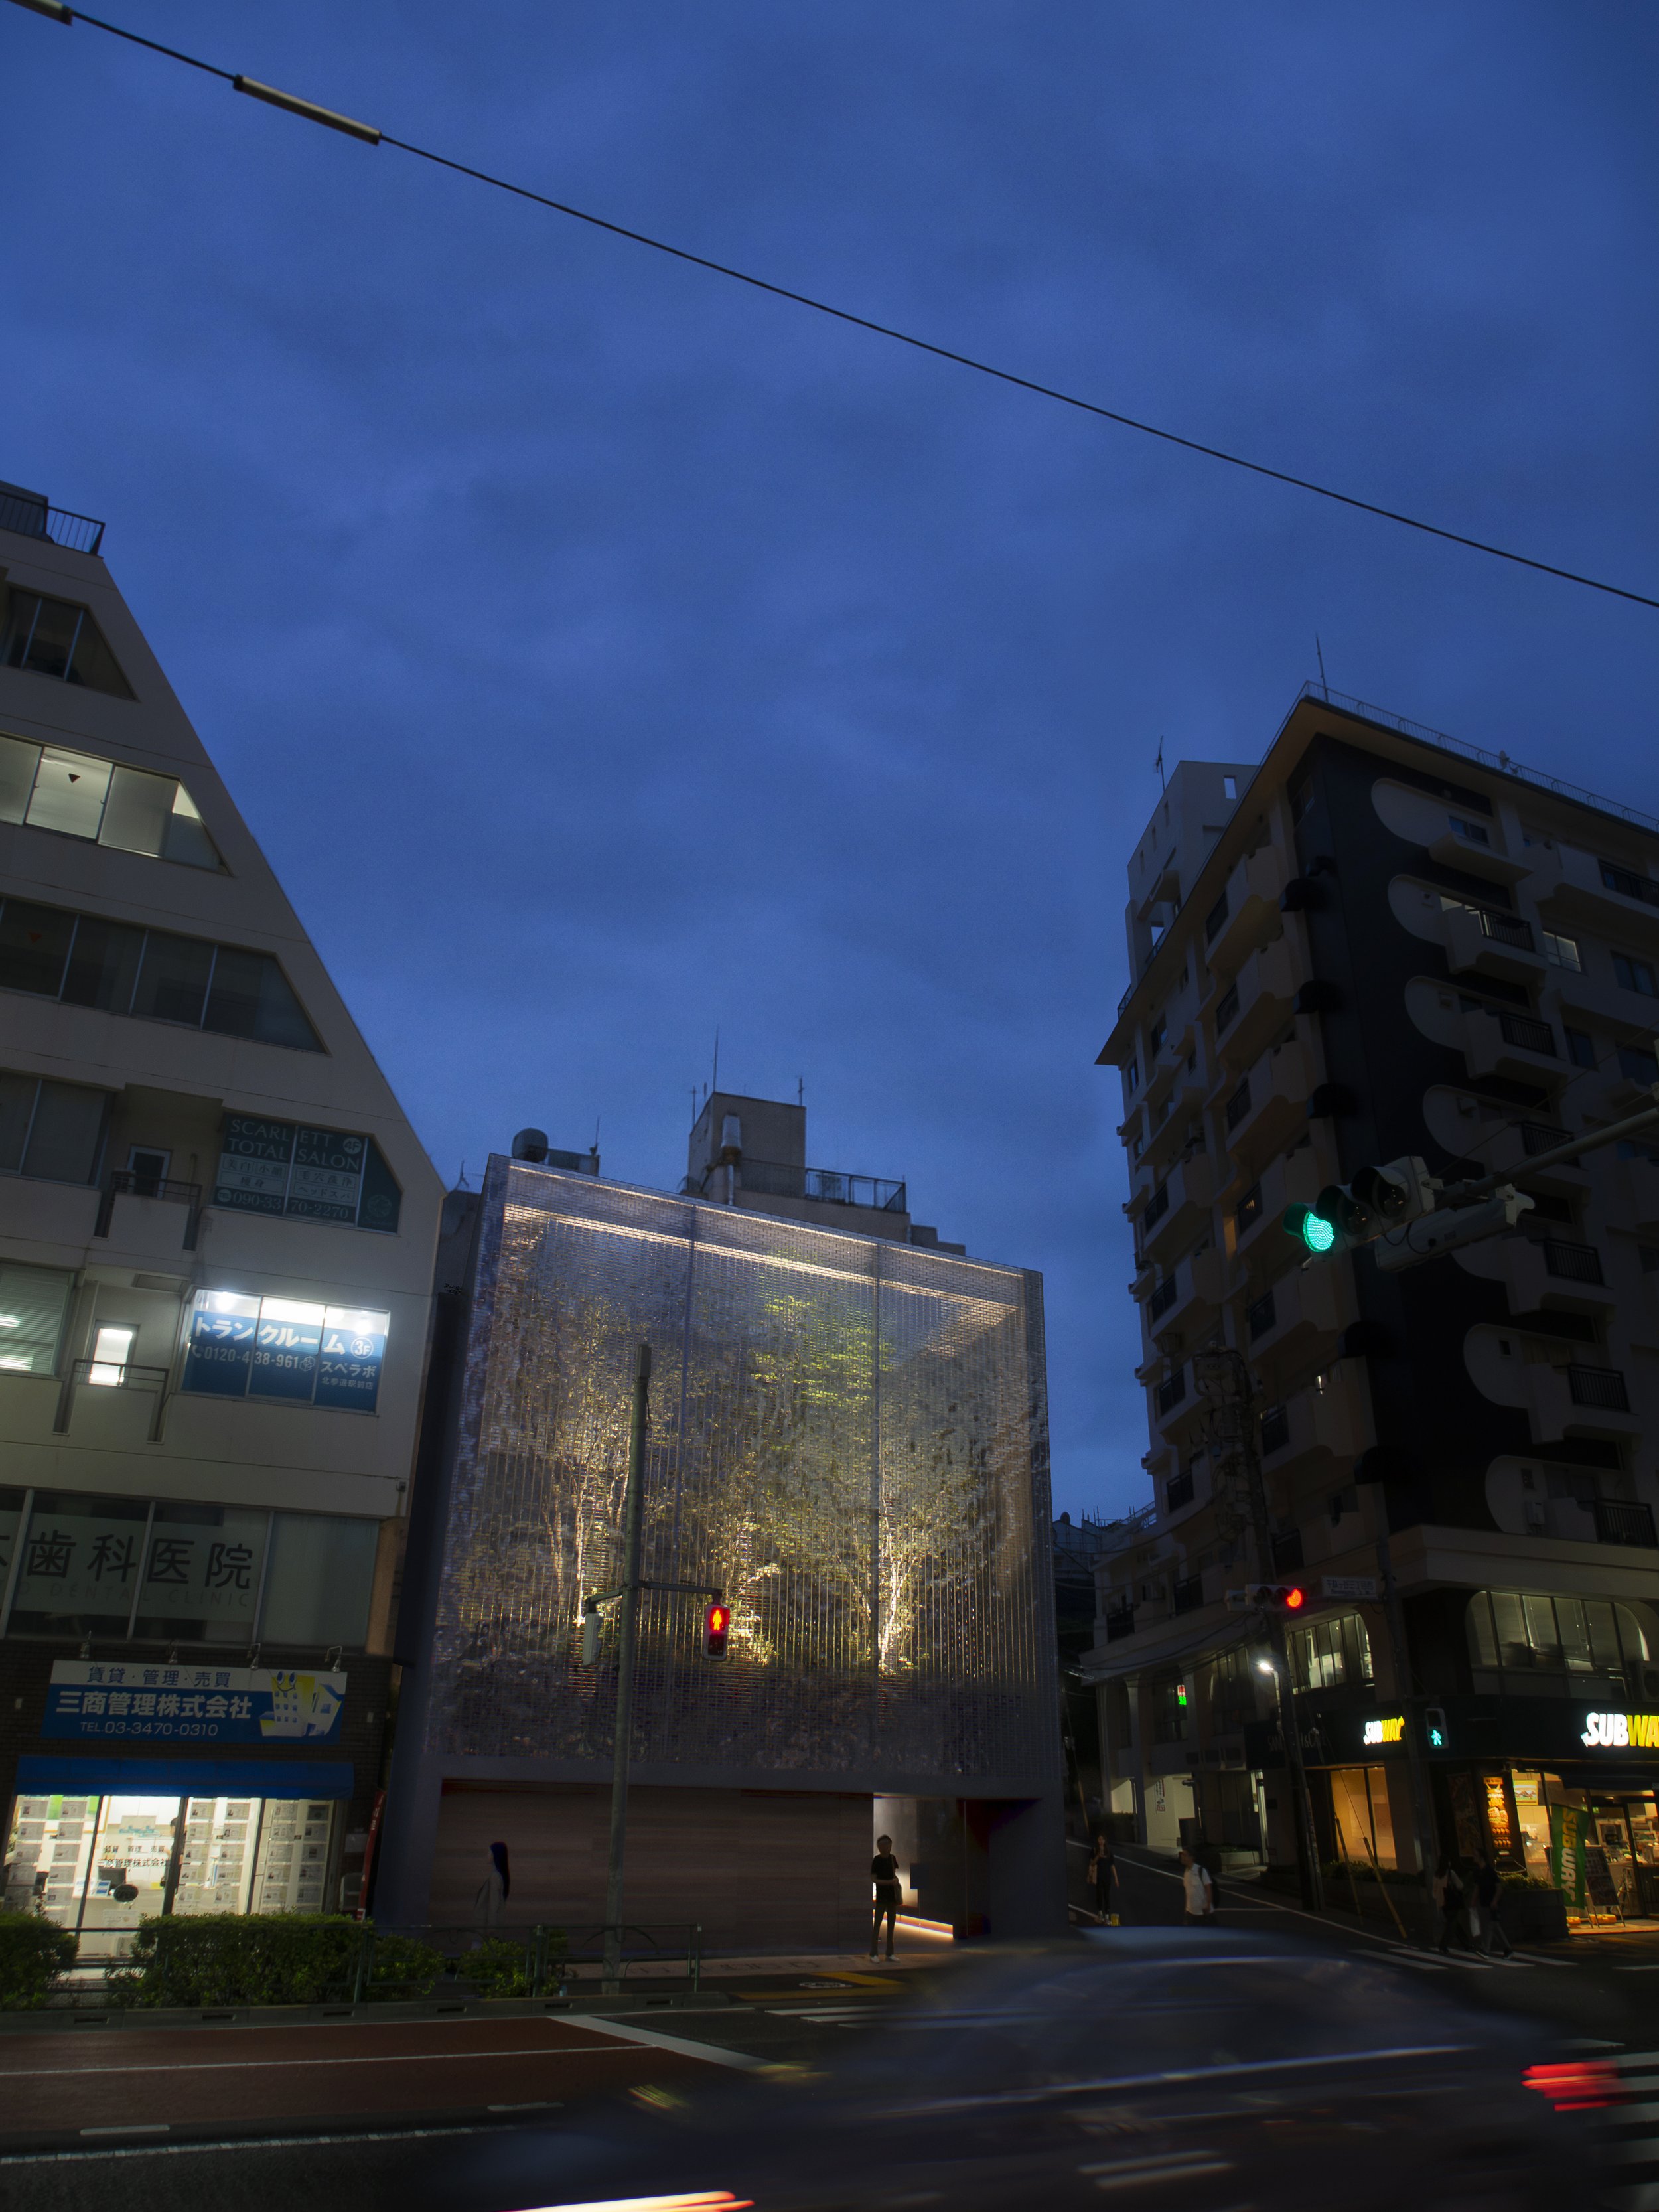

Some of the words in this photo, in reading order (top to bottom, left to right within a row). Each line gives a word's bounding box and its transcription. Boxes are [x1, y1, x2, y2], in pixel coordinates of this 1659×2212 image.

[228, 1138, 287, 1160] TOTAL
[297, 1149, 360, 1171] SALON
[344, 1138, 361, 1153] 4F
[195, 1316, 346, 1355] トランクルーム
[353, 1339, 372, 1356] 3F
[204, 1347, 299, 1370] 0120-438-961
[50, 1582, 151, 1601] DENTAL
[169, 1584, 248, 1607] CLINIC
[56, 1690, 252, 1720] 三商管理株式会社
[1363, 1716, 1406, 1745] SUBWAY
[1581, 1712, 1659, 1747] SUBWA
[1561, 1807, 1578, 1902] SUBWAY
